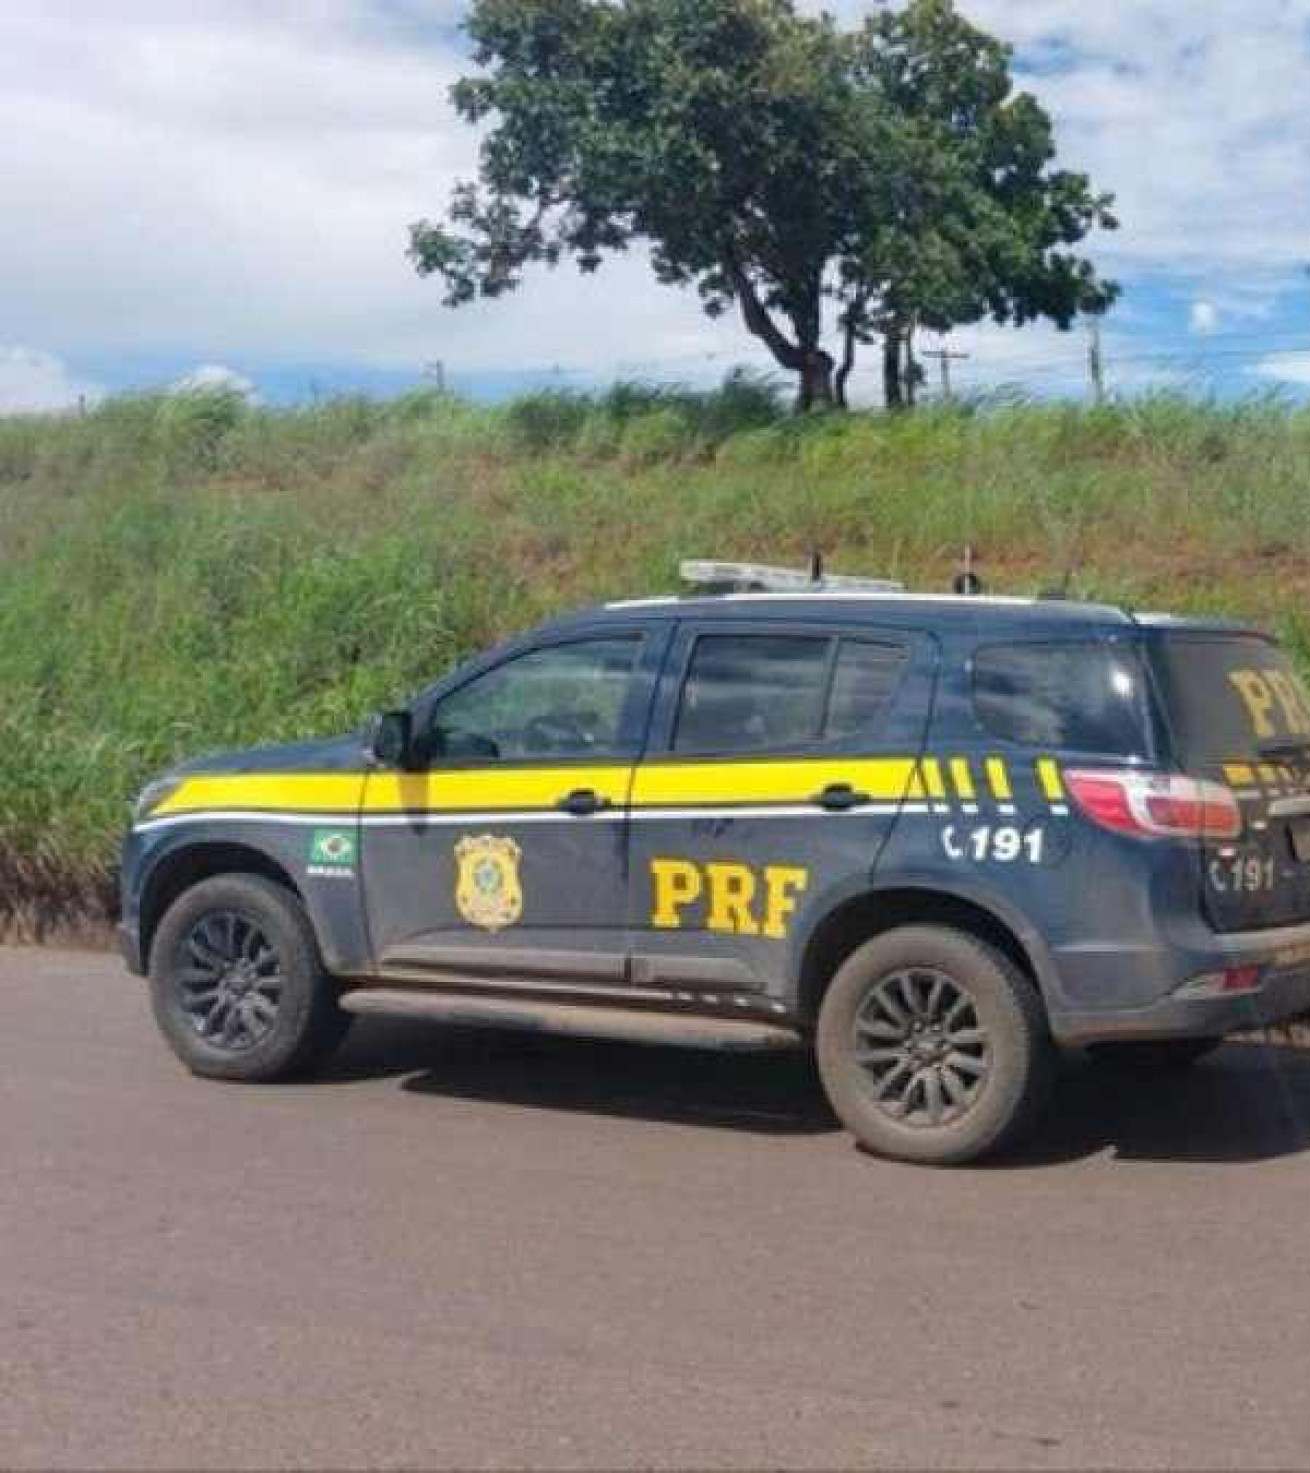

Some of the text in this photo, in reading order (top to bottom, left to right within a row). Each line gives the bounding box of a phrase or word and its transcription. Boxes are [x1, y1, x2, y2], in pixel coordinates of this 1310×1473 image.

[971, 826, 1042, 863] 191
[1232, 857, 1274, 891] 191
[651, 859, 808, 939] PRF
